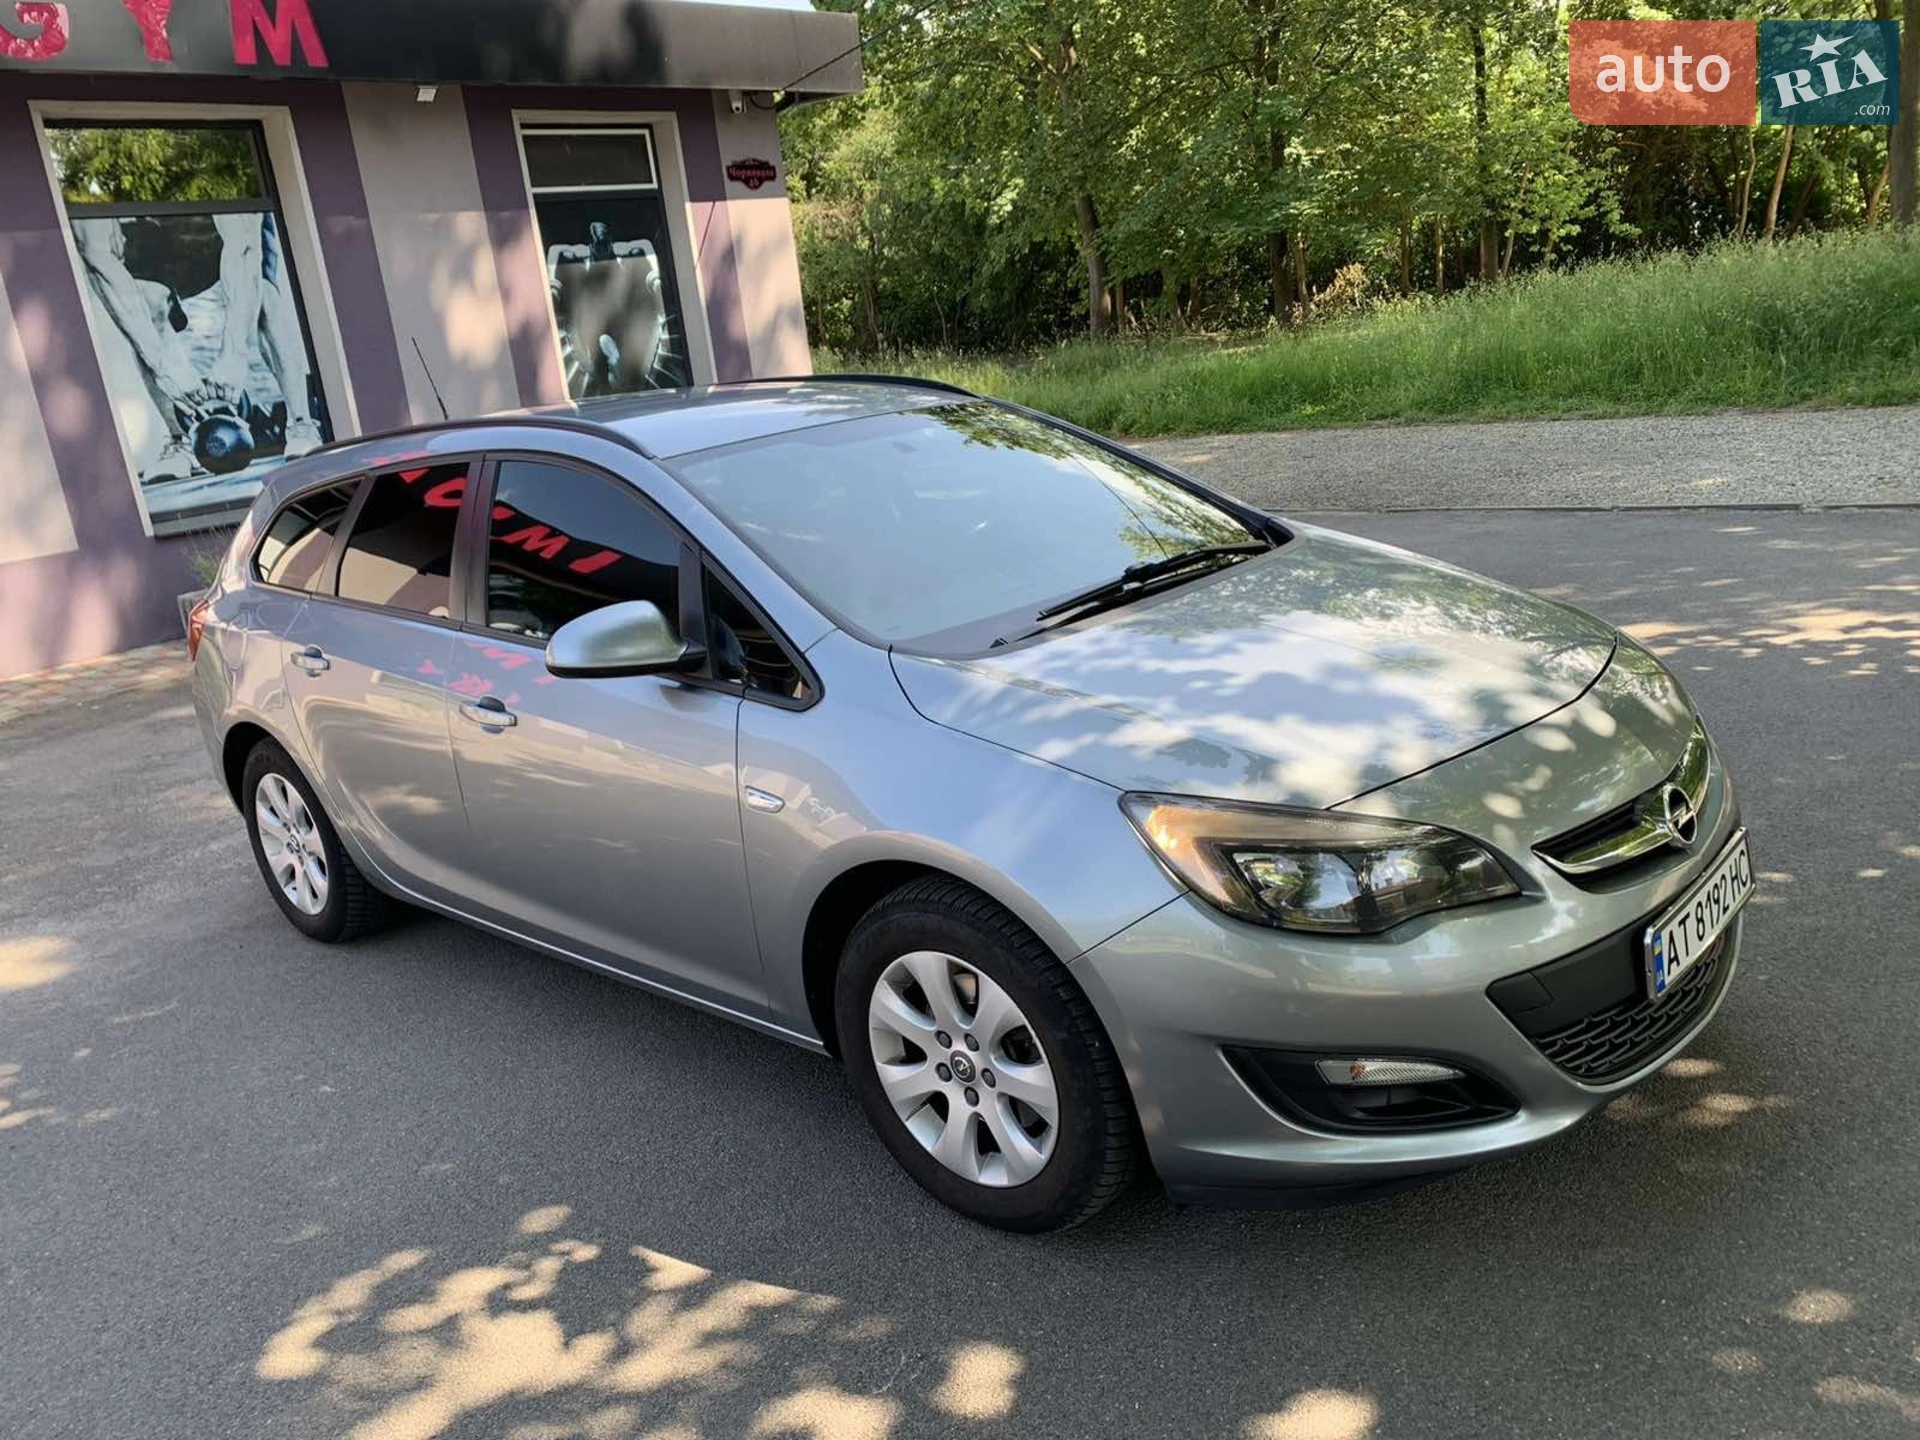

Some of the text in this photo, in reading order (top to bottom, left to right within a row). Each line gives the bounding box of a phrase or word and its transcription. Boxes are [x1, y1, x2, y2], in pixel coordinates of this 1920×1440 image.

[1666, 848, 1750, 976] AT 8192 HC
